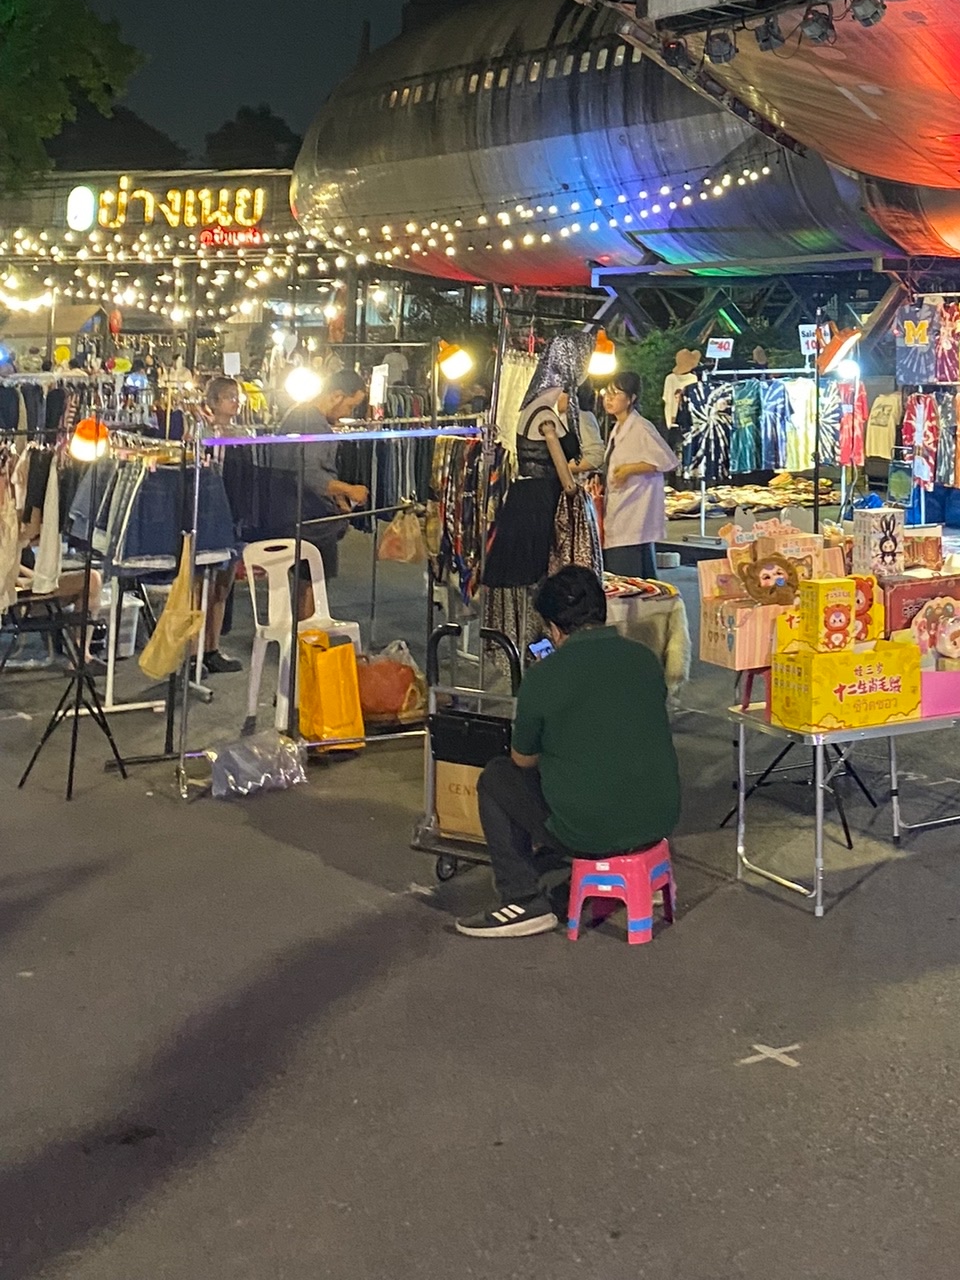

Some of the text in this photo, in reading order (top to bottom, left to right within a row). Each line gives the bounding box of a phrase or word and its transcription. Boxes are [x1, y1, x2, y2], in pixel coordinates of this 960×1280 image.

[99, 176, 265, 228] ย่างเนย
[904, 320, 929, 347] M
[449, 782, 477, 796] CEN
